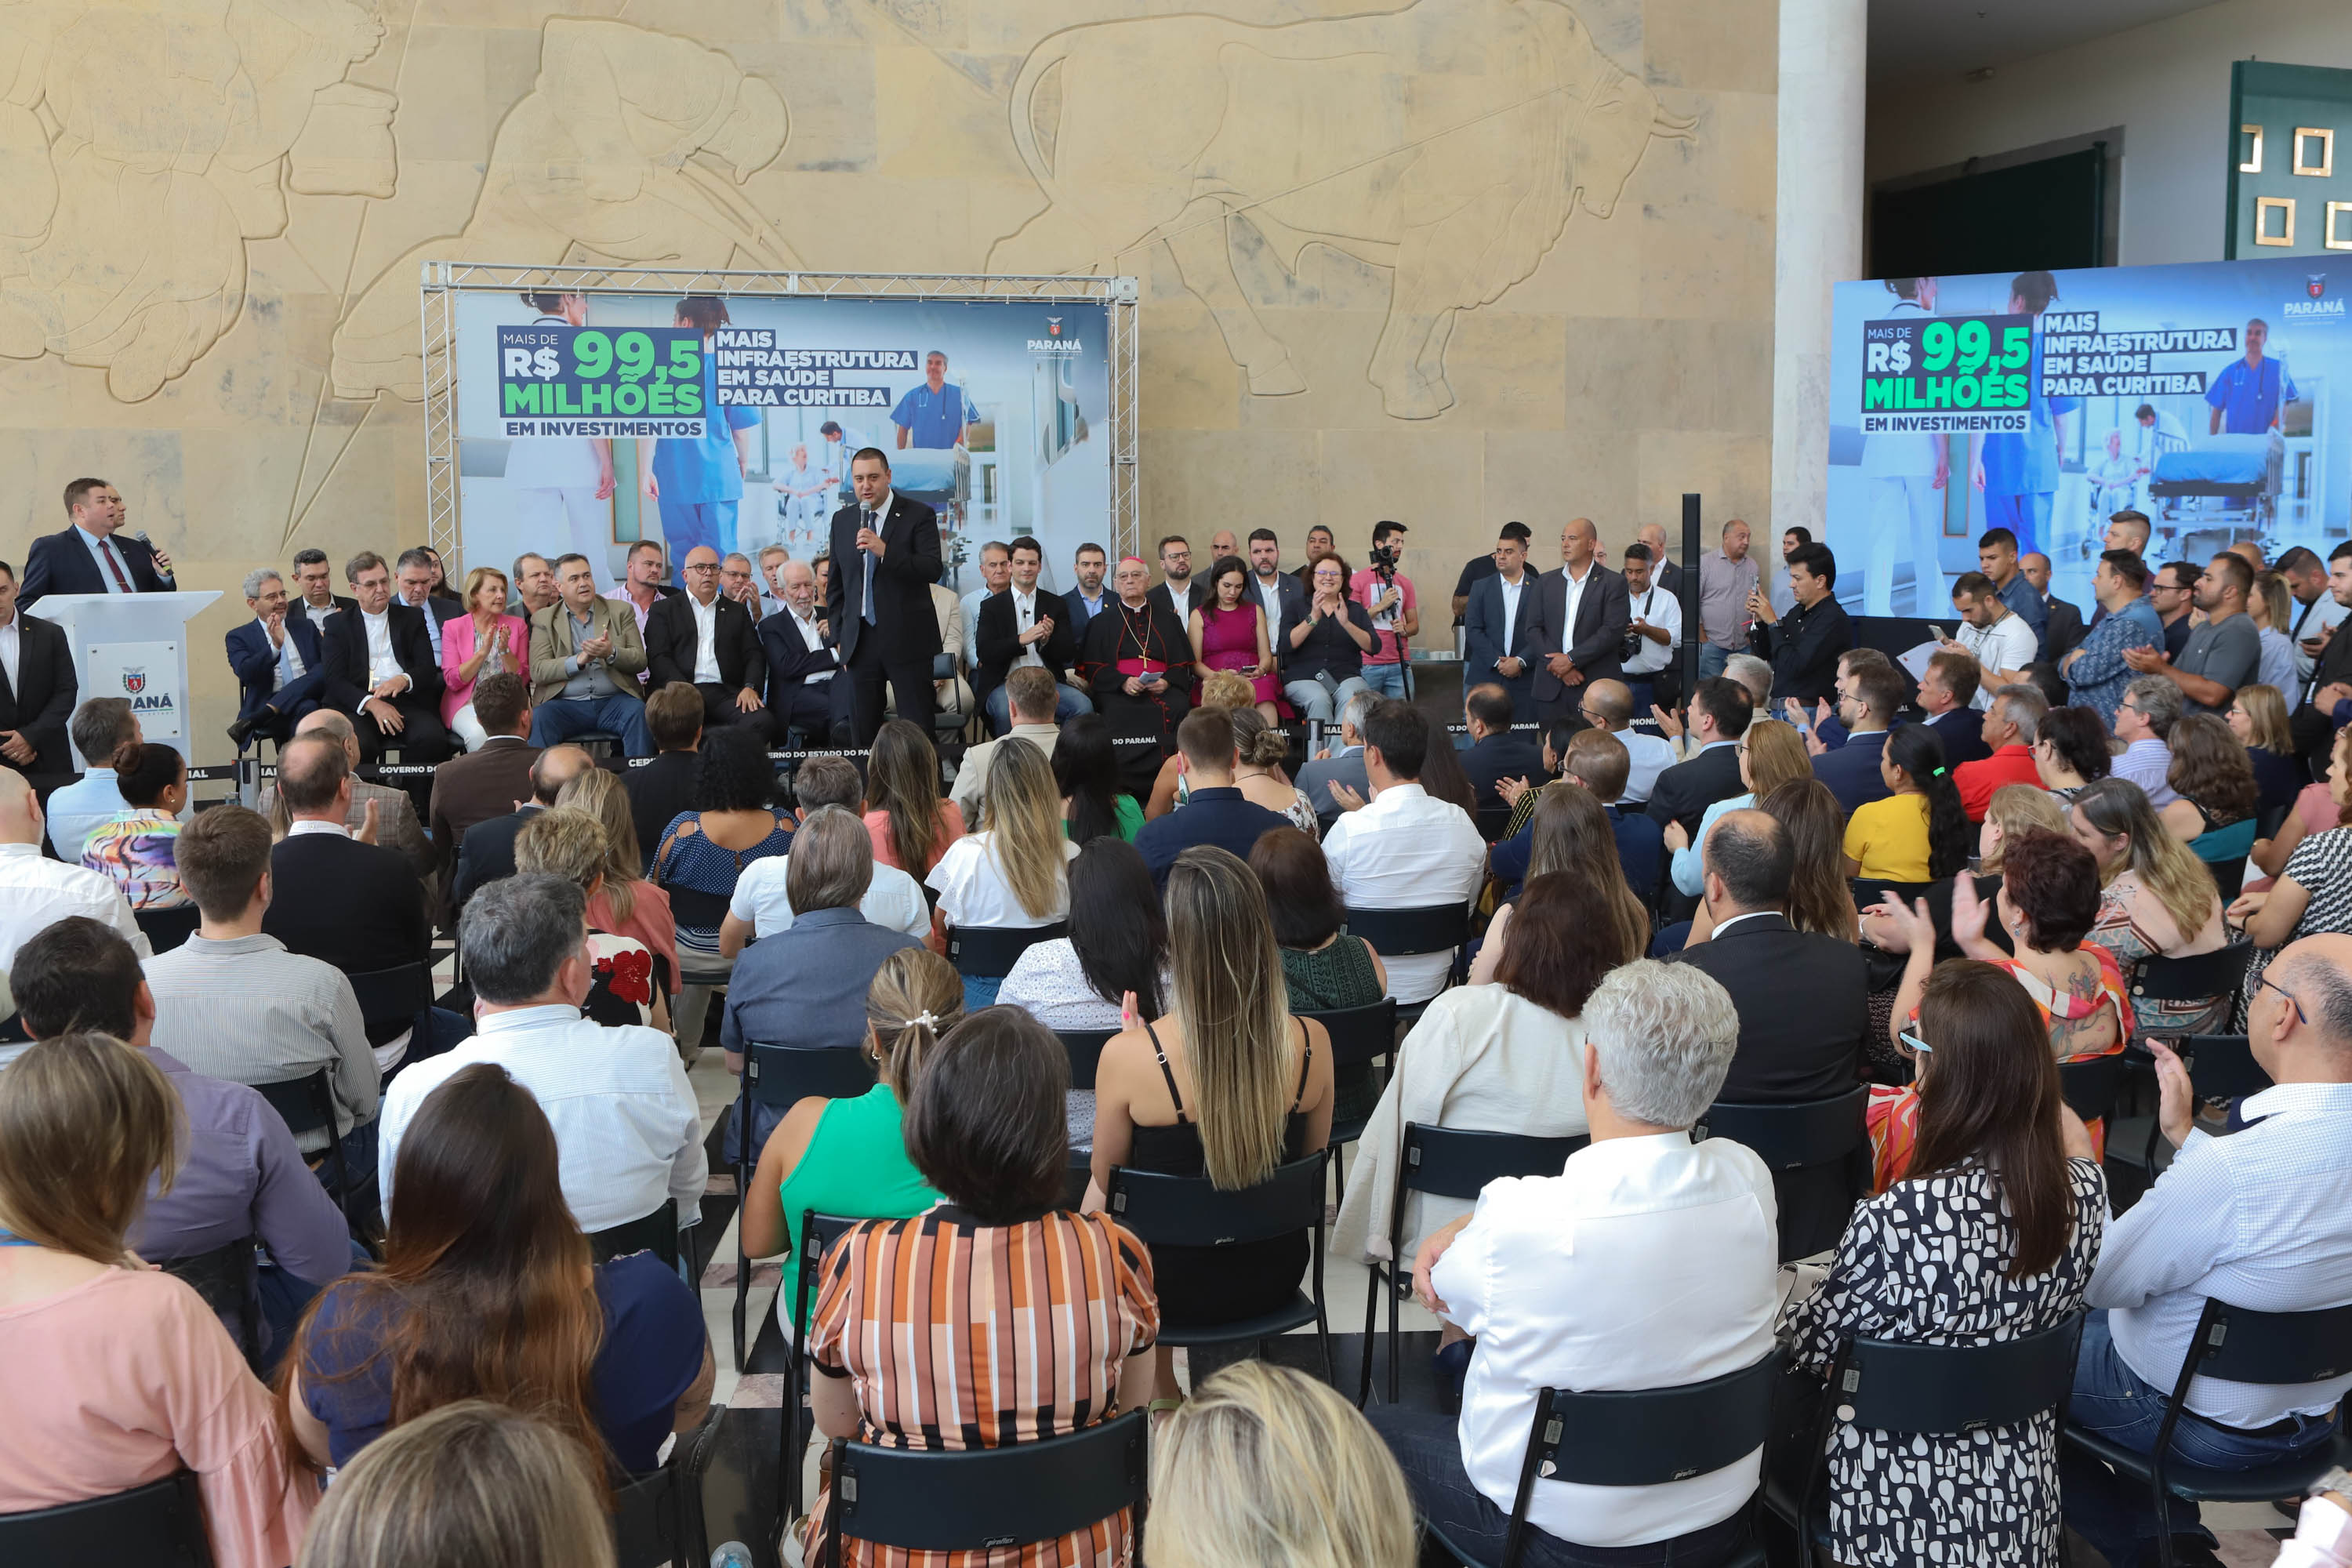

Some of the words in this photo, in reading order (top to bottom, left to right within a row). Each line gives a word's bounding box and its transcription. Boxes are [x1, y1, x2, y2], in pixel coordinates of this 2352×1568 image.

[2283, 298, 2346, 314] PARANÁ
[2045, 314, 2096, 333] MAIS
[503, 334, 536, 345] MAIS
[541, 334, 558, 345] DE
[717, 331, 773, 348] MAIS
[1867, 328, 1894, 339] MAIS
[1896, 327, 1912, 338] DE
[2044, 329, 2234, 354] INFRAESTRUTURA
[1027, 338, 1082, 350] PARANÁ
[1867, 339, 1911, 376] R$
[1922, 320, 2030, 376] 99,5
[504, 346, 561, 381] R$
[572, 330, 701, 385] 99,5
[717, 350, 916, 368] INFRAESTRUTURA
[2043, 357, 2073, 375] EM
[2076, 352, 2148, 374] SAÚDE
[717, 369, 750, 386] EM
[754, 366, 829, 387] SAÚDE
[2042, 377, 2098, 396] PARA
[2102, 375, 2202, 394] CURITIBA
[504, 373, 702, 415] MILHÕES
[1865, 365, 2029, 409] MILHÕES
[718, 388, 779, 405] PARA
[783, 388, 887, 406] CURITIBA
[506, 422, 535, 436] EM
[540, 422, 702, 436] INVESTIMENTOS
[1865, 417, 1887, 432] EM
[1892, 415, 2026, 431] INVESTIMENTOS
[129, 692, 173, 710] ANÁ
[1510, 721, 1541, 730] PARANÁ
[1125, 735, 1157, 745] PARANÁ
[808, 750, 842, 758] ESTADO
